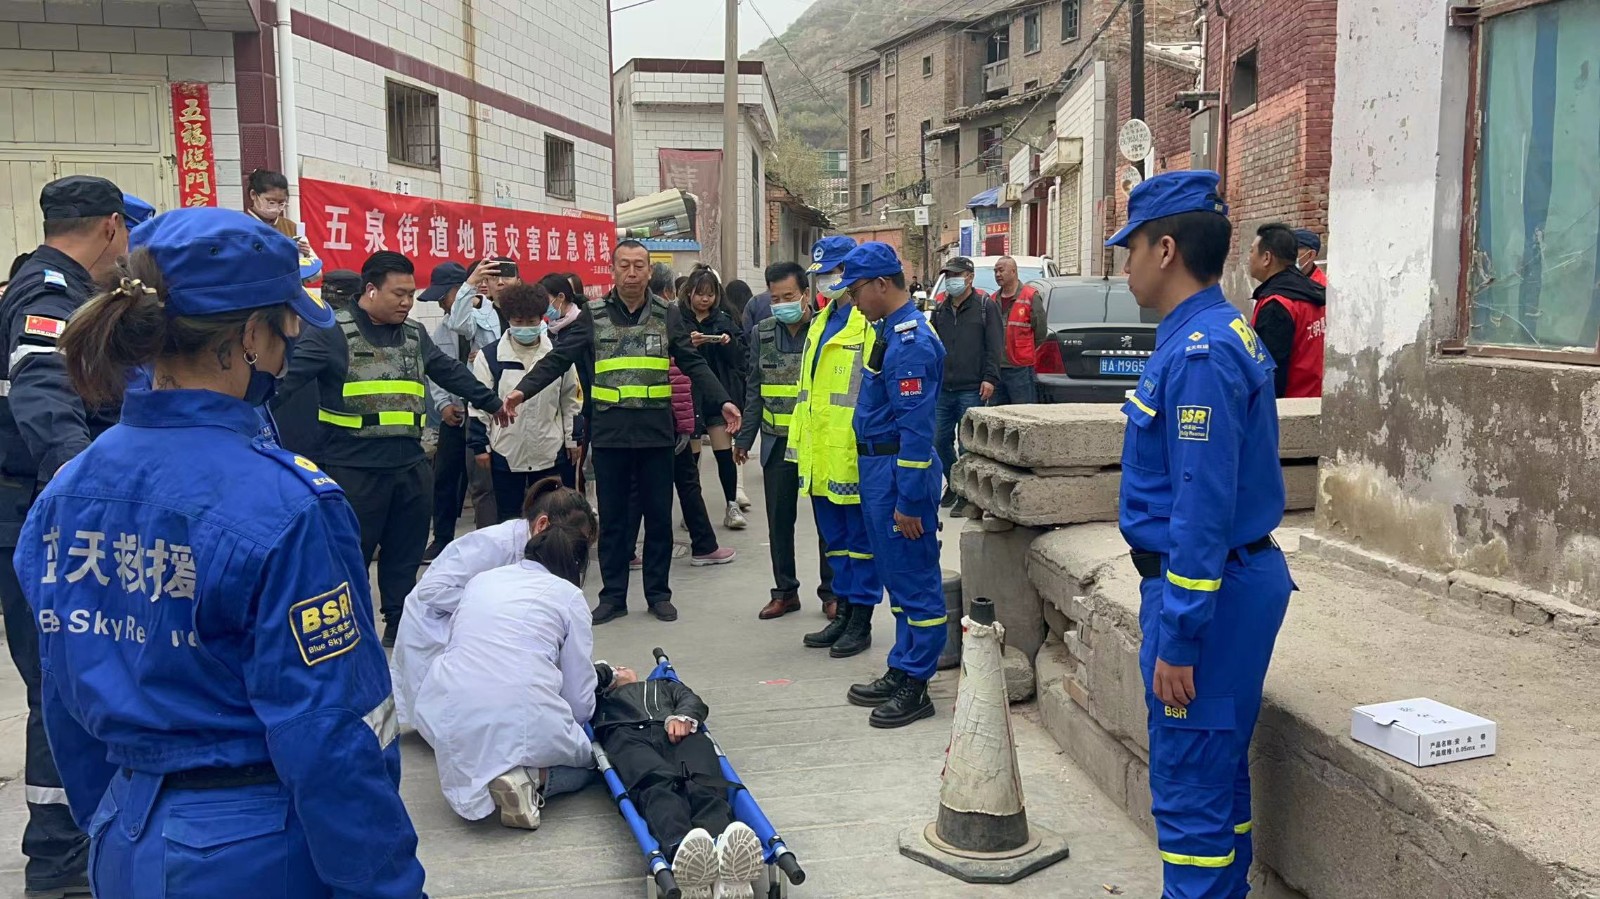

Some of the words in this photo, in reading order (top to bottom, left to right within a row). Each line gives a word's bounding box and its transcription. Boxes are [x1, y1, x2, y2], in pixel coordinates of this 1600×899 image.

[323, 204, 612, 263] 五泉街道地质灾害应急演练
[1101, 359, 1147, 373] 甘A·M9G5
[1181, 409, 1207, 424] BSR
[301, 593, 349, 634] BSR
[67, 609, 123, 642] Sky
[308, 643, 326, 654] Blue
[328, 636, 343, 647] Sky
[1164, 705, 1187, 719] BSR
